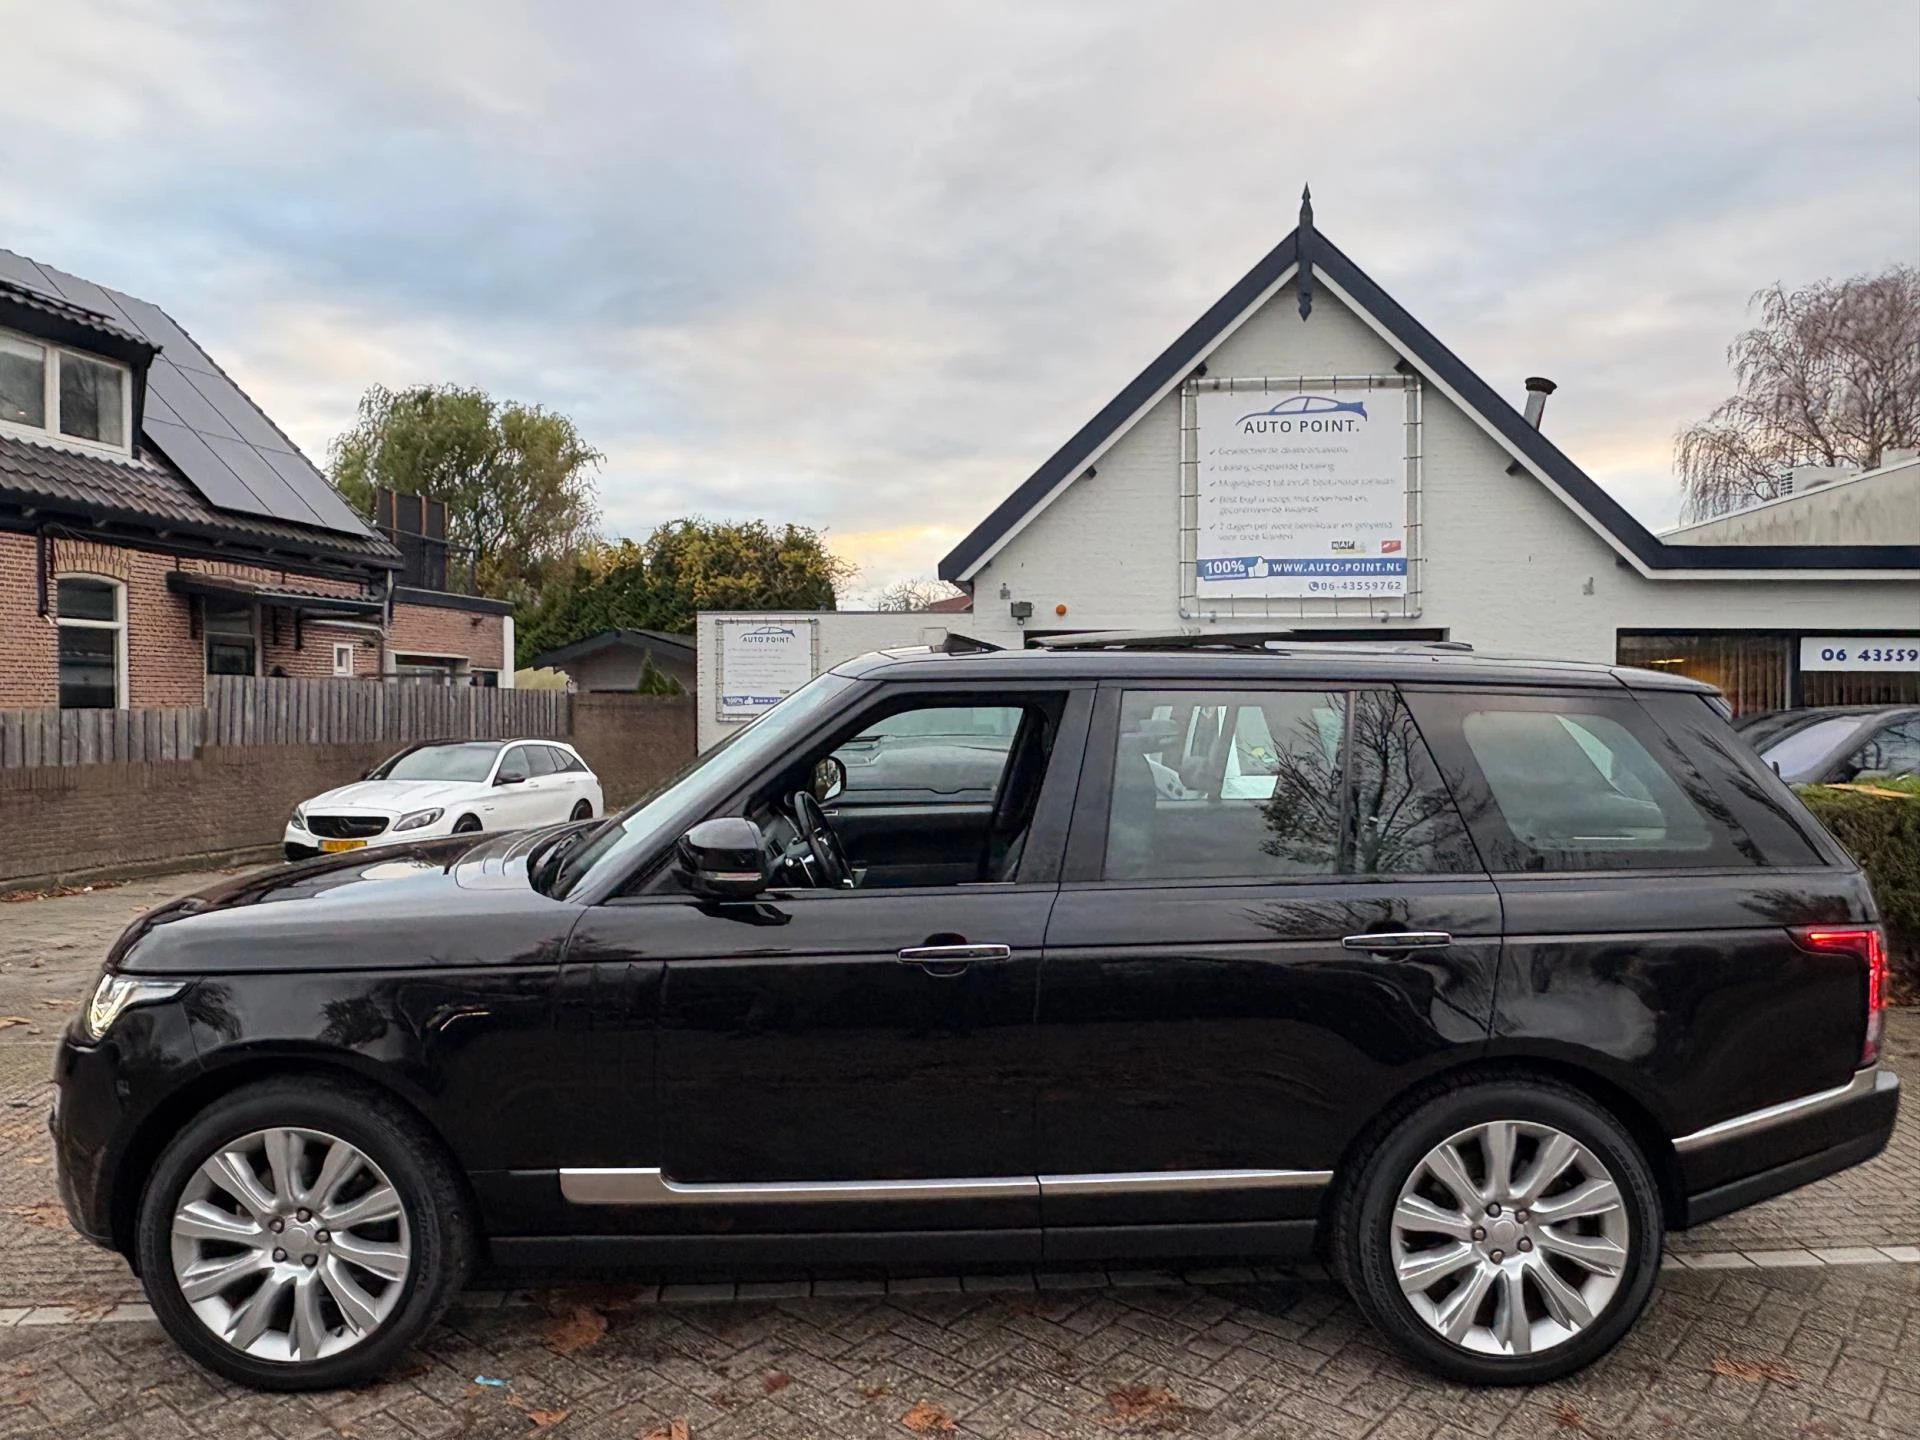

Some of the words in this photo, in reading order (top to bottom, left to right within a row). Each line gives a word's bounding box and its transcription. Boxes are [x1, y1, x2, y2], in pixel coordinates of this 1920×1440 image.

[1244, 420, 1292, 434] AUTO
[1205, 560, 1245, 575] 100%
[1321, 581, 1401, 591] 06-43559762
[1821, 649, 1847, 661] 06
[1857, 649, 1919, 662] 43559
